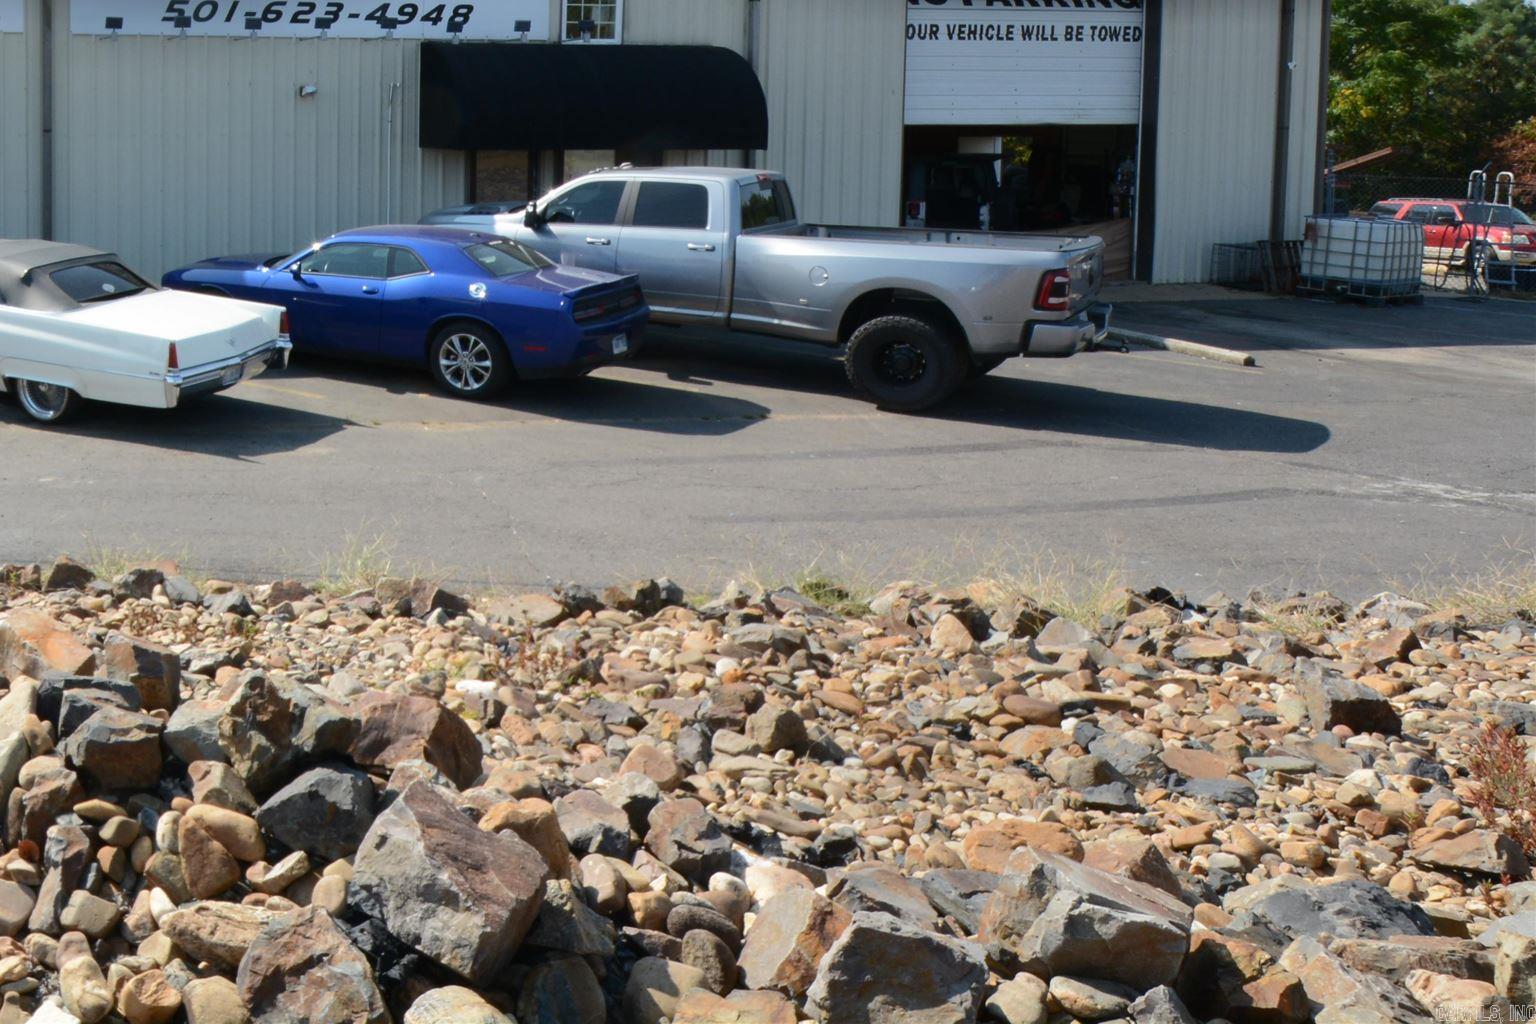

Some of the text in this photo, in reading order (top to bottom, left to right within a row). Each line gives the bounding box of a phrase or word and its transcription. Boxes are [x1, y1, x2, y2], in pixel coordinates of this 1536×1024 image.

[161, 0, 475, 26] 501-623-4948
[906, 23, 1143, 42] OUR VEHICLE WILL BE TOWED
